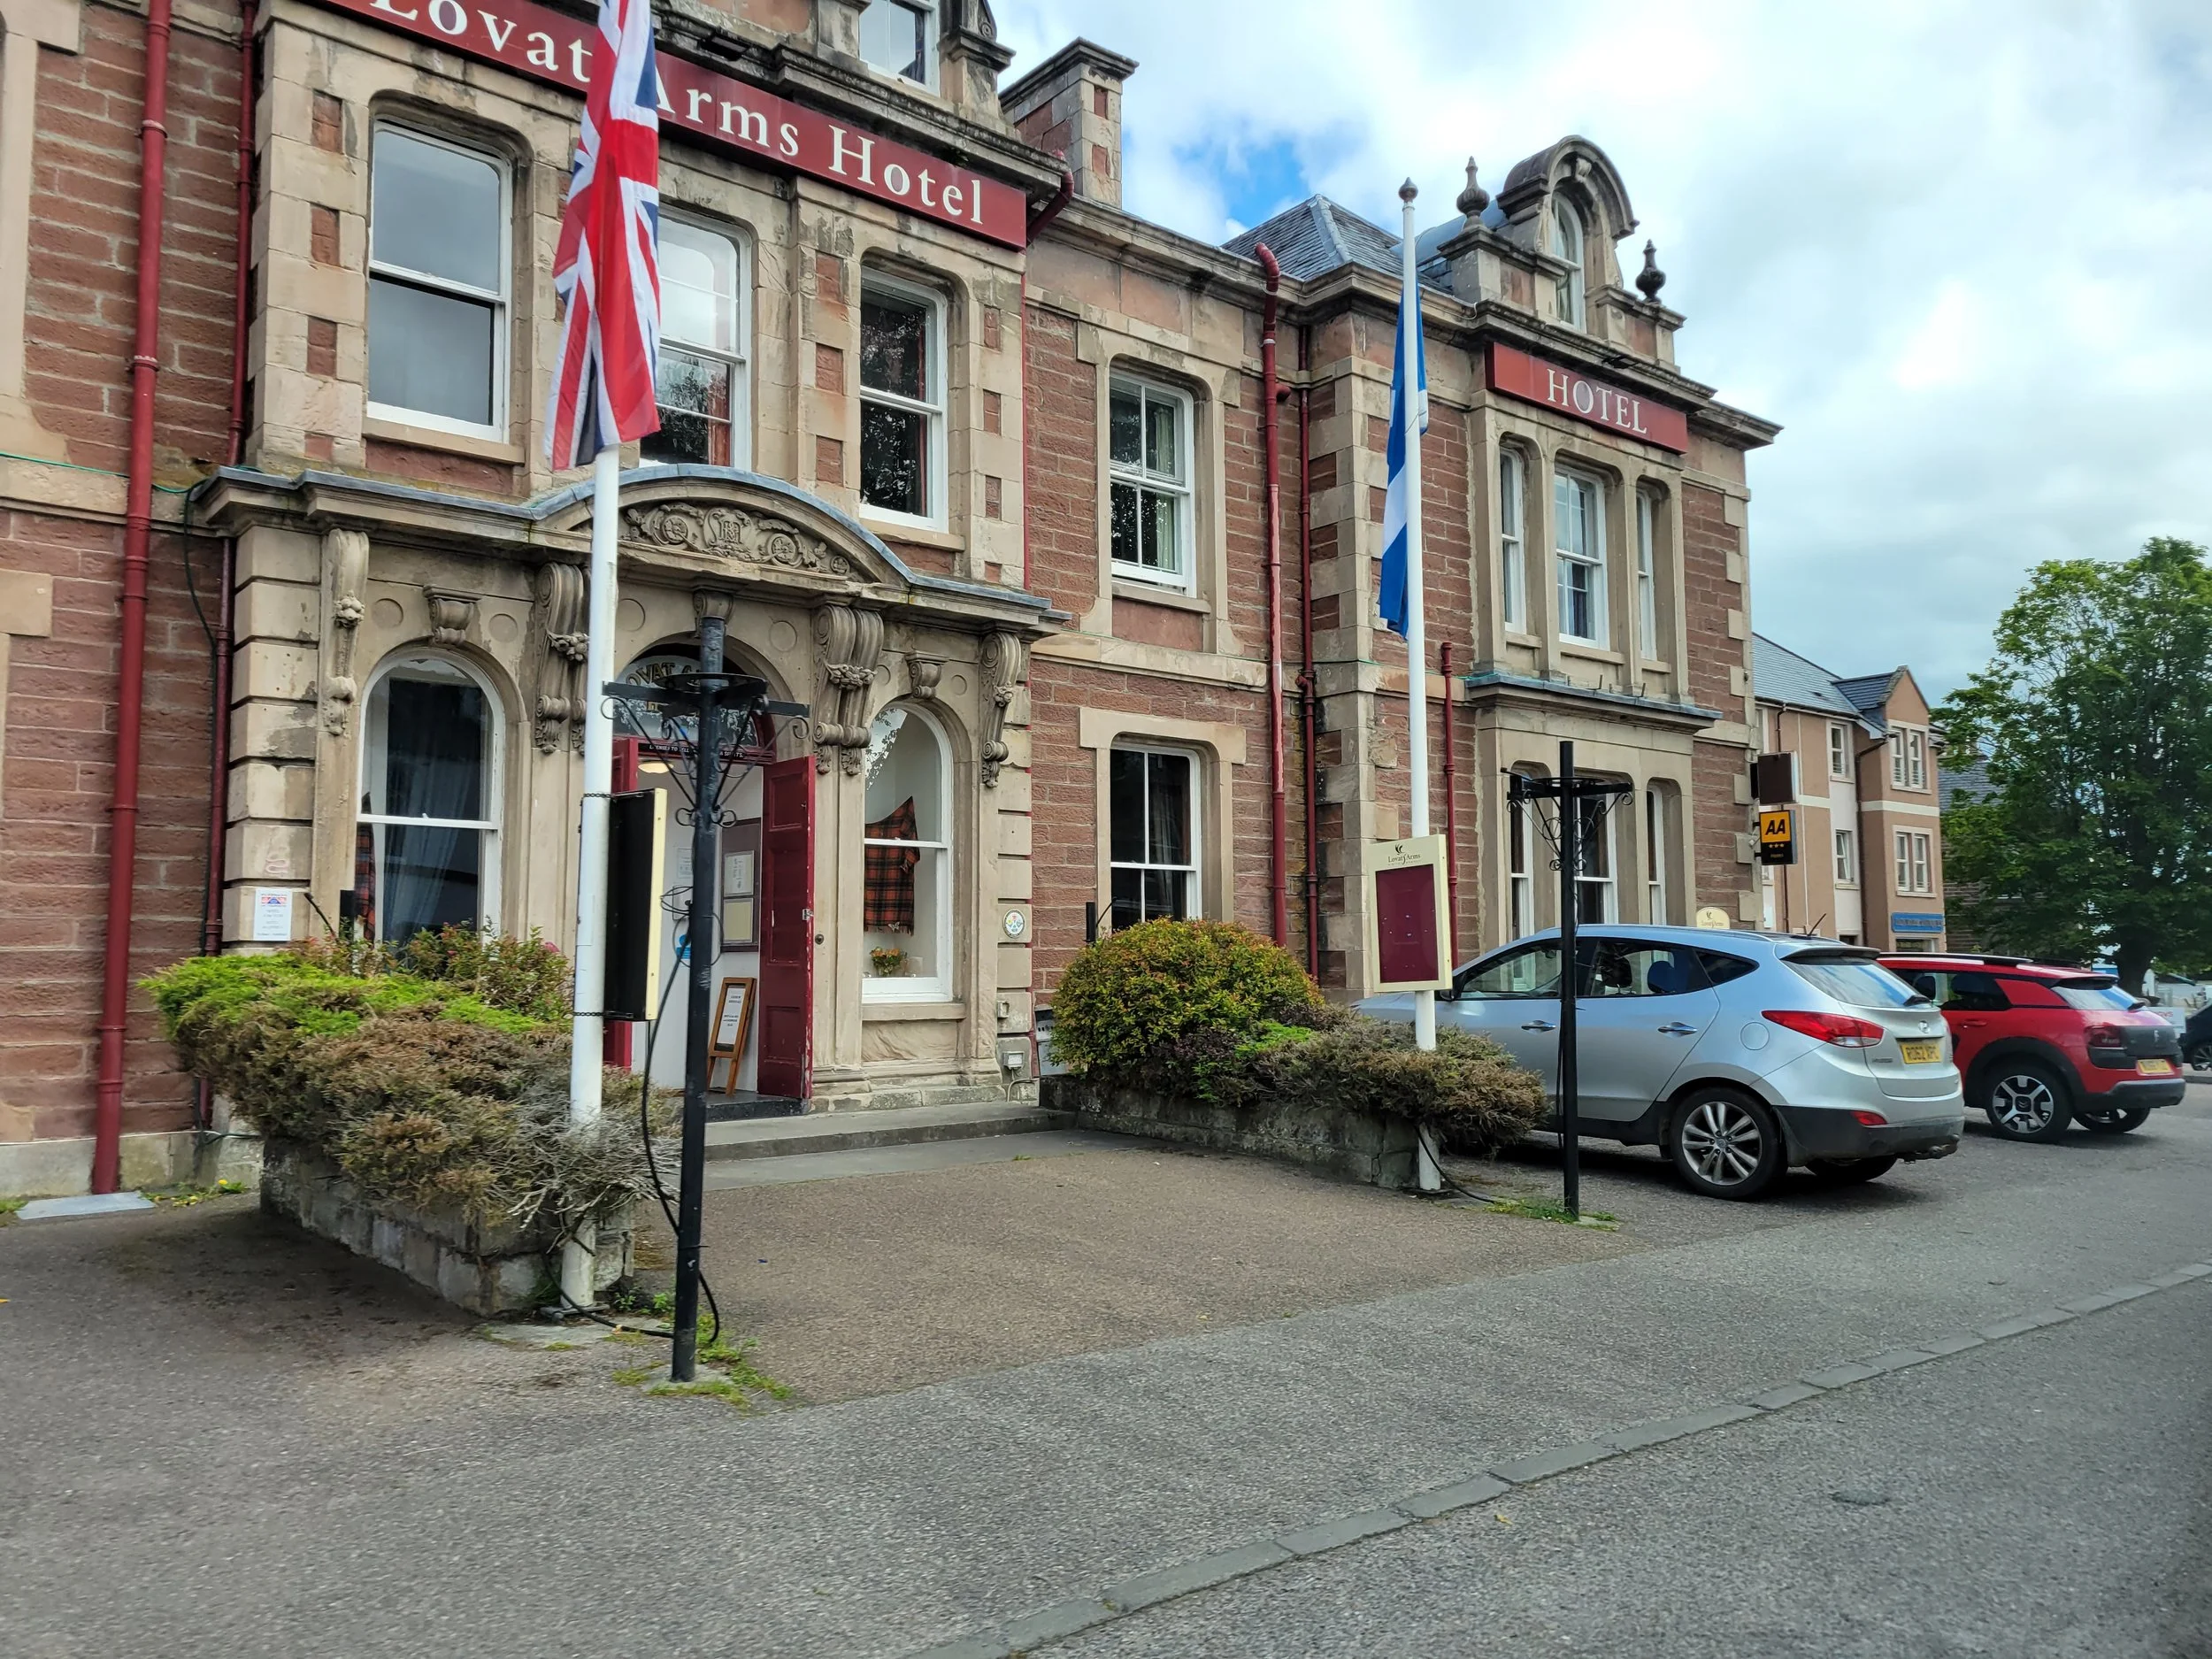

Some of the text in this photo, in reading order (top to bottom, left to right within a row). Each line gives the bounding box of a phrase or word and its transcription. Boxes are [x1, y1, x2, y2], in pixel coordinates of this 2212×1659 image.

[828, 125, 983, 225] Hotel
[1547, 368, 1647, 434] HOTEL
[1765, 818, 1786, 835] AA
